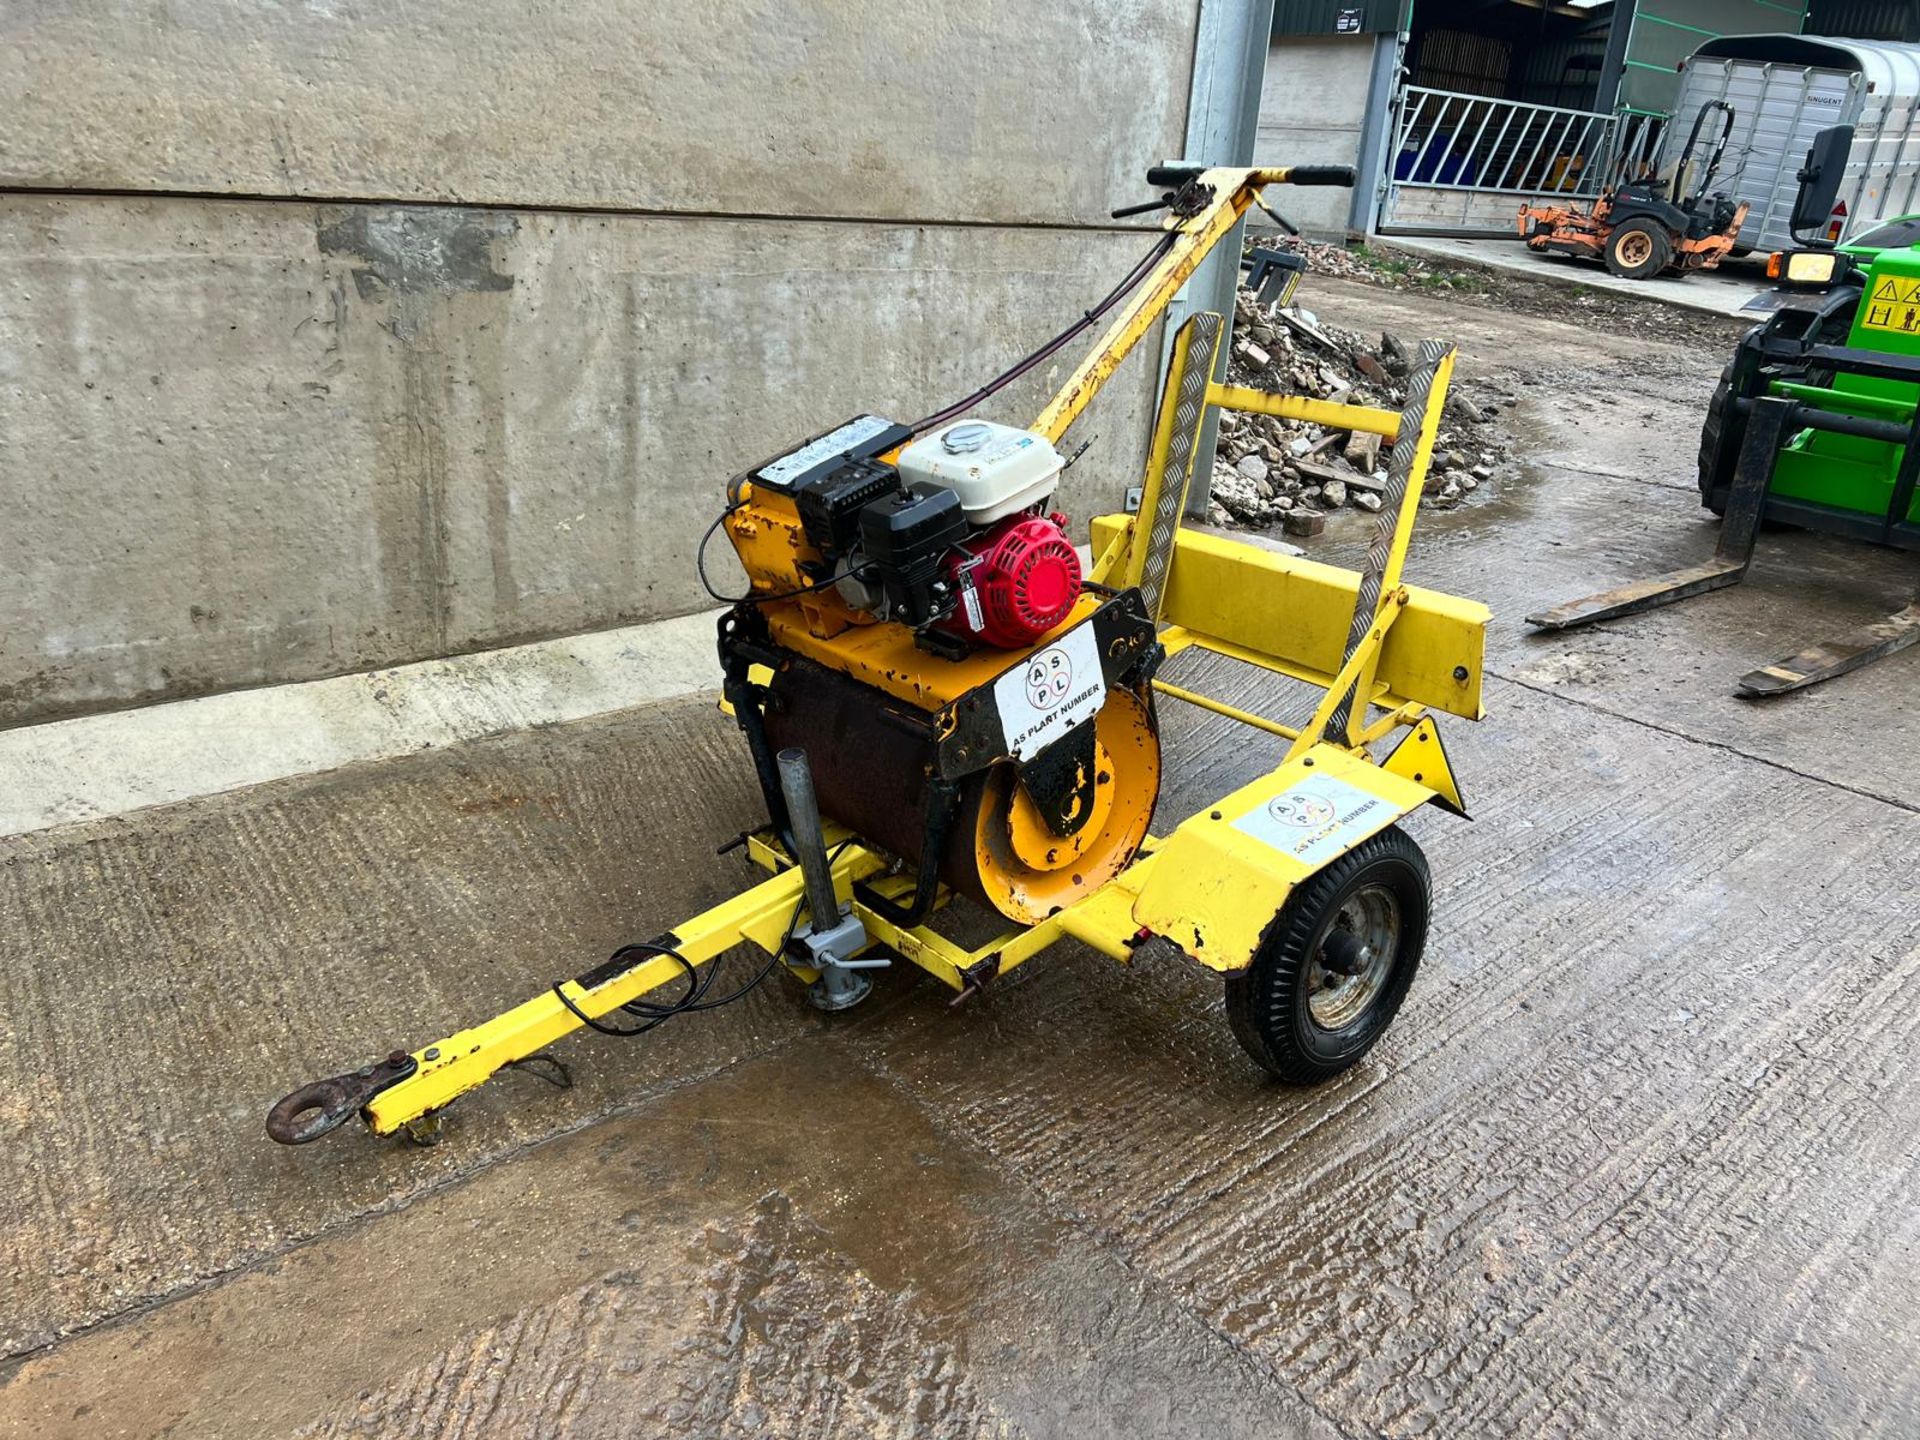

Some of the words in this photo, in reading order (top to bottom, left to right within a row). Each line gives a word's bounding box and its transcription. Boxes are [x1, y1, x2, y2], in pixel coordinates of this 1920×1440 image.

[1012, 733, 1027, 748] AS
[1060, 683, 1101, 715] NUMBER
[1341, 799, 1380, 825] NUMBER
